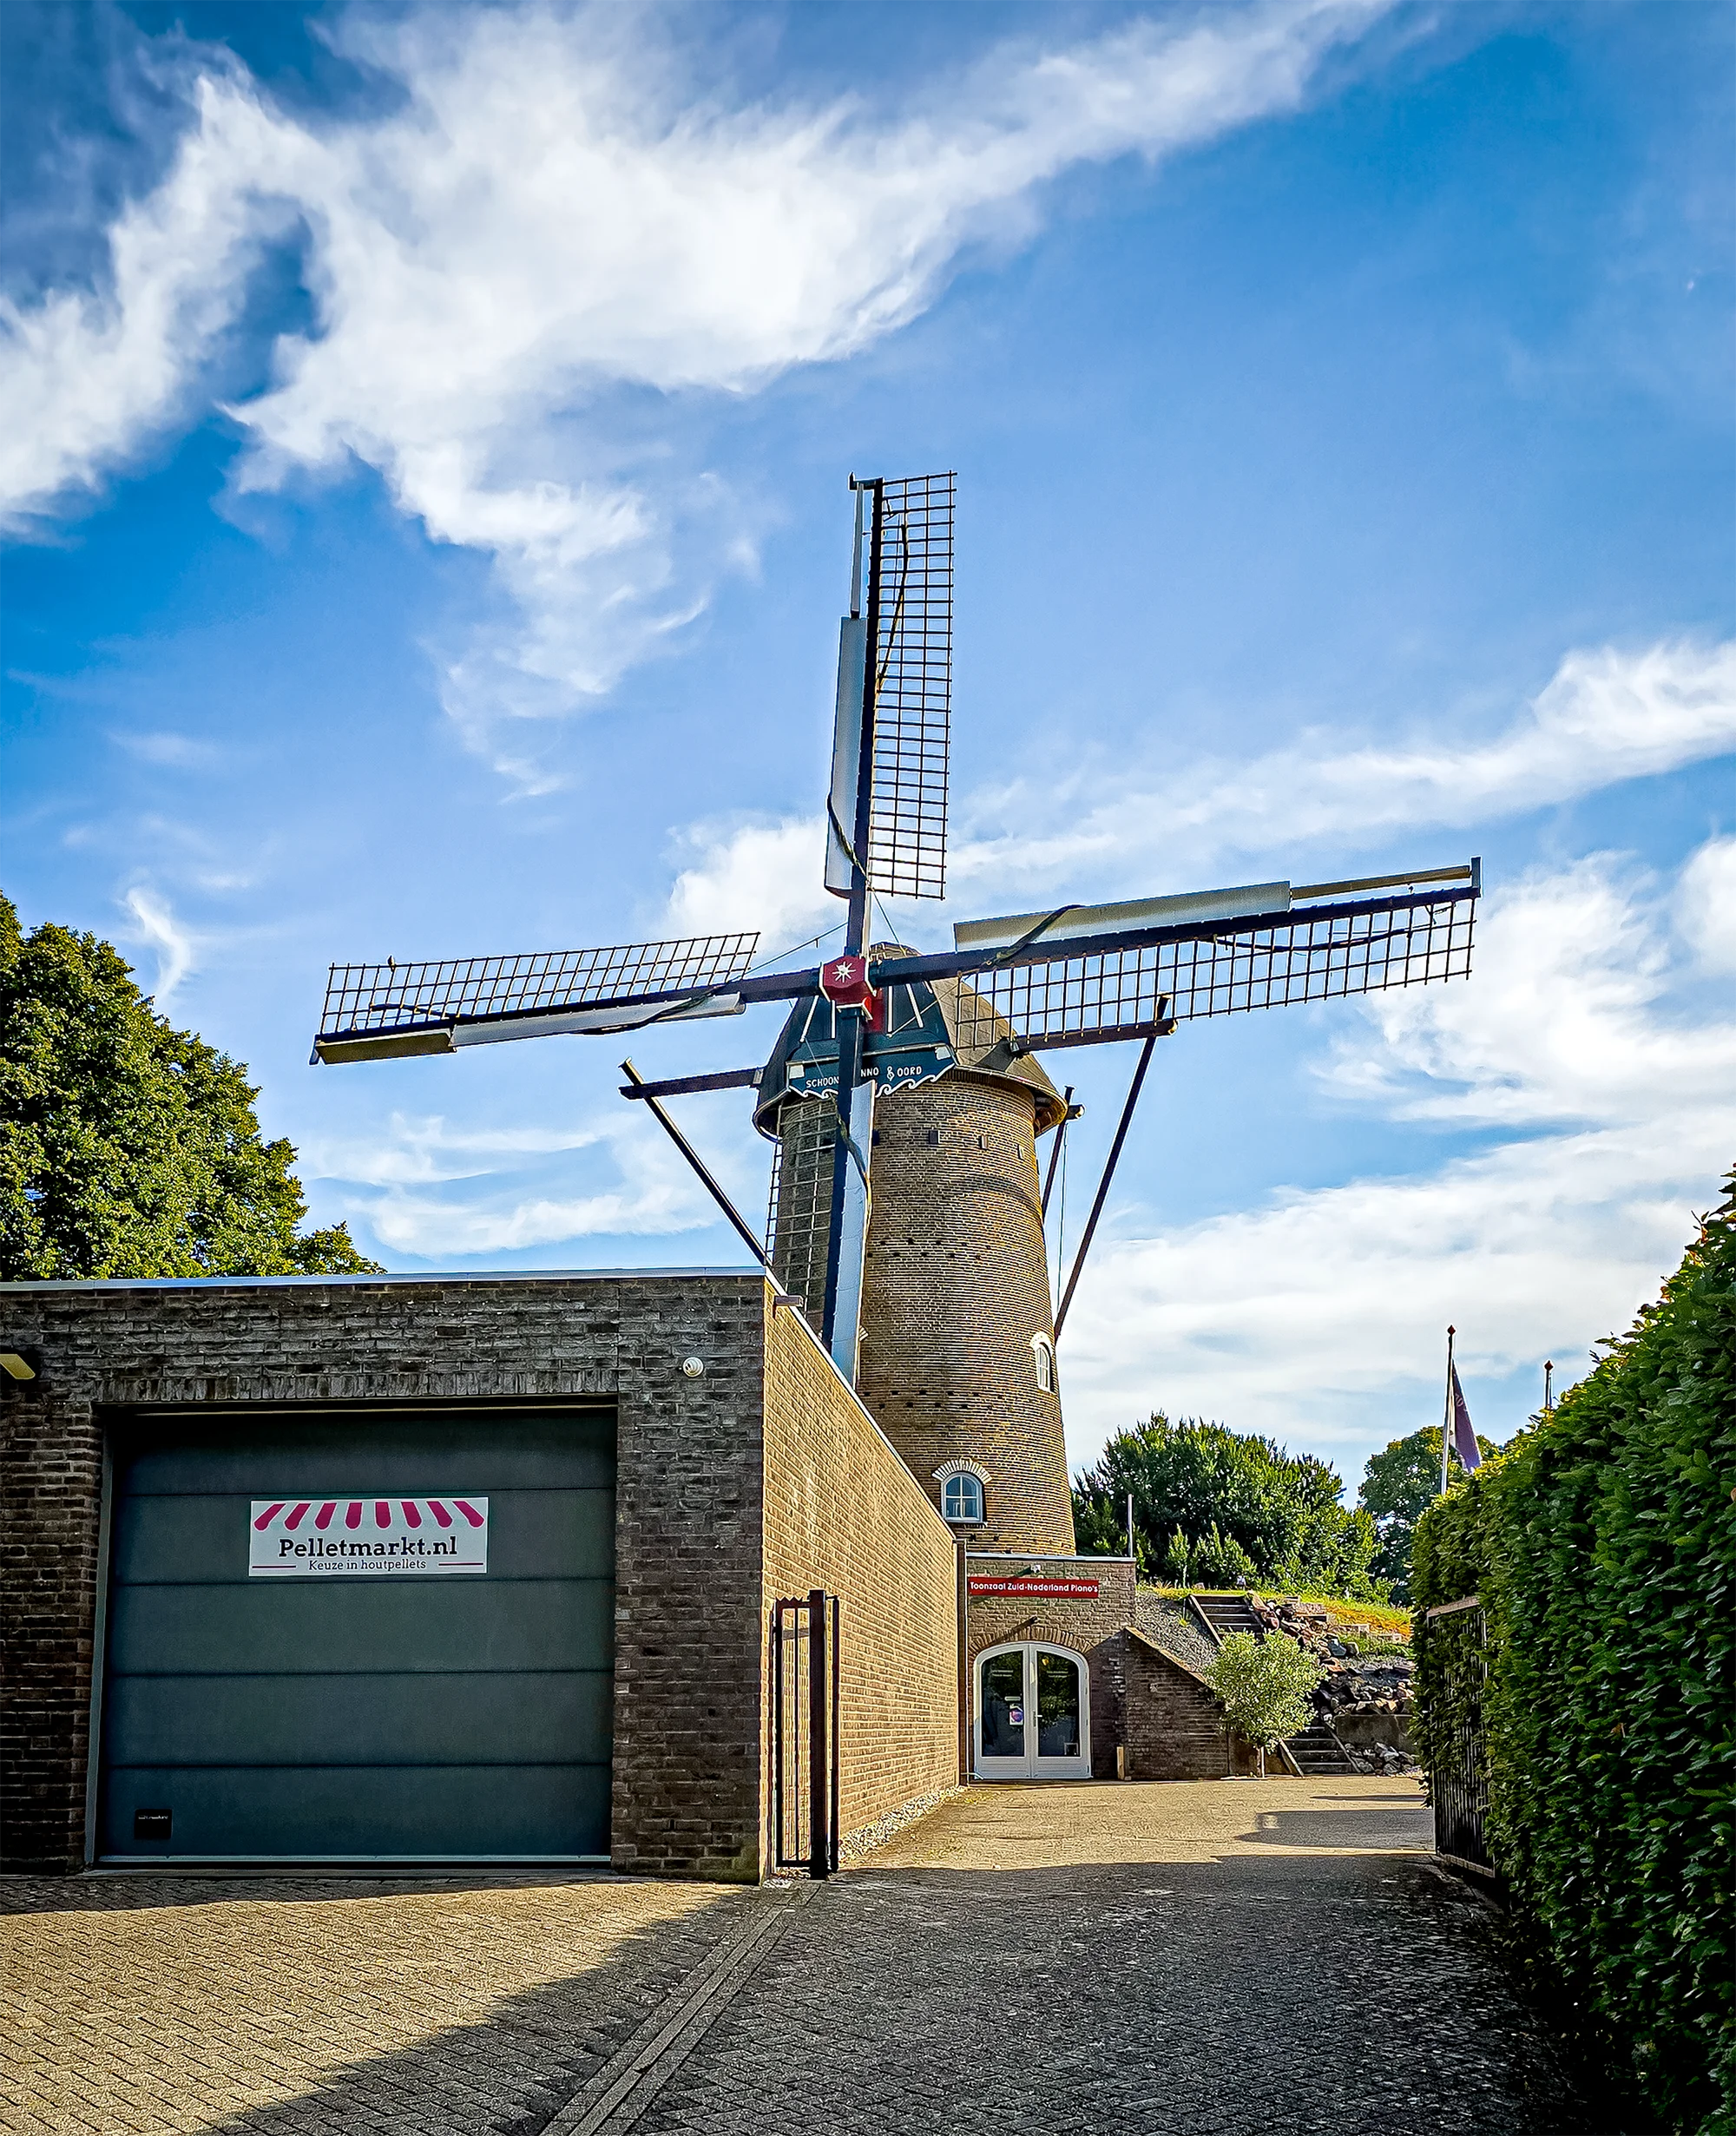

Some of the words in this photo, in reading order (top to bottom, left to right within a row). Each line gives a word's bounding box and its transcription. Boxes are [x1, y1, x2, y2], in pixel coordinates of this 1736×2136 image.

[806, 1075, 839, 1088] SCHOON
[860, 1067, 879, 1077] NNO
[897, 1066, 922, 1077] OORD
[279, 1535, 457, 1557] Pelletmarkt.nl
[309, 1561, 344, 1570] Keuze
[346, 1560, 357, 1569] in
[360, 1559, 426, 1571] houtpellets
